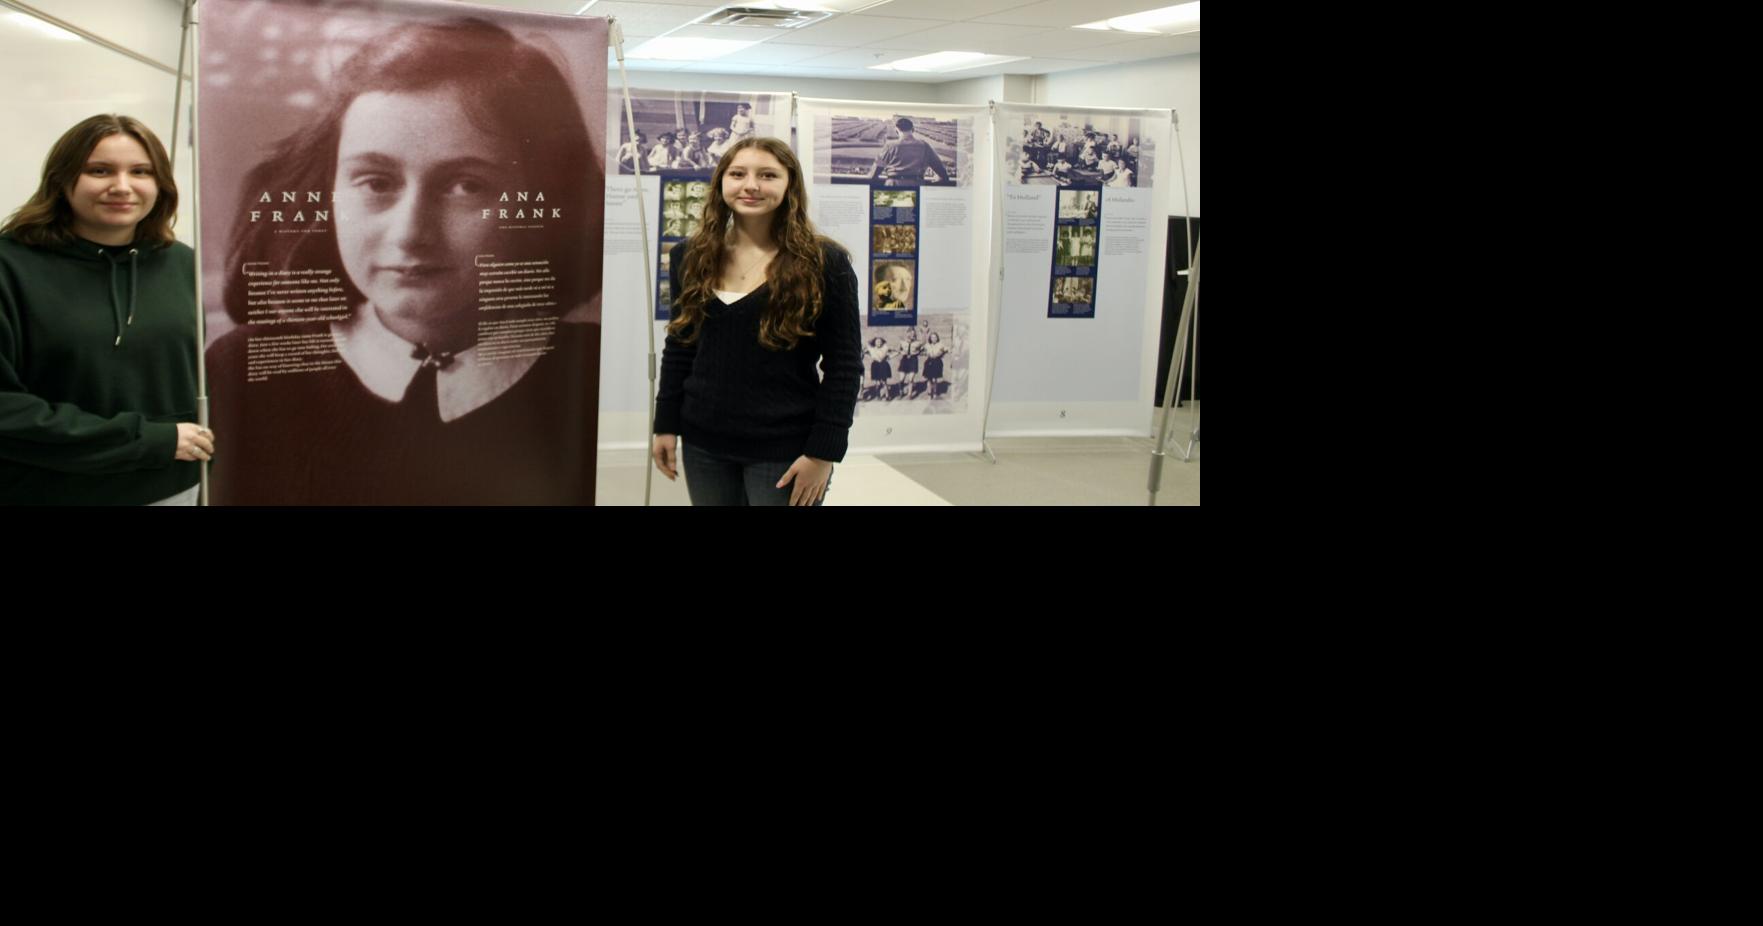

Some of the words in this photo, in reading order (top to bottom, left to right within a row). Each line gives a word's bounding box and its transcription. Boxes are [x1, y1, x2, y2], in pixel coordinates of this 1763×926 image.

[499, 192, 544, 202] ANA
[250, 210, 350, 222] FRANK
[482, 208, 561, 219] FRANK
